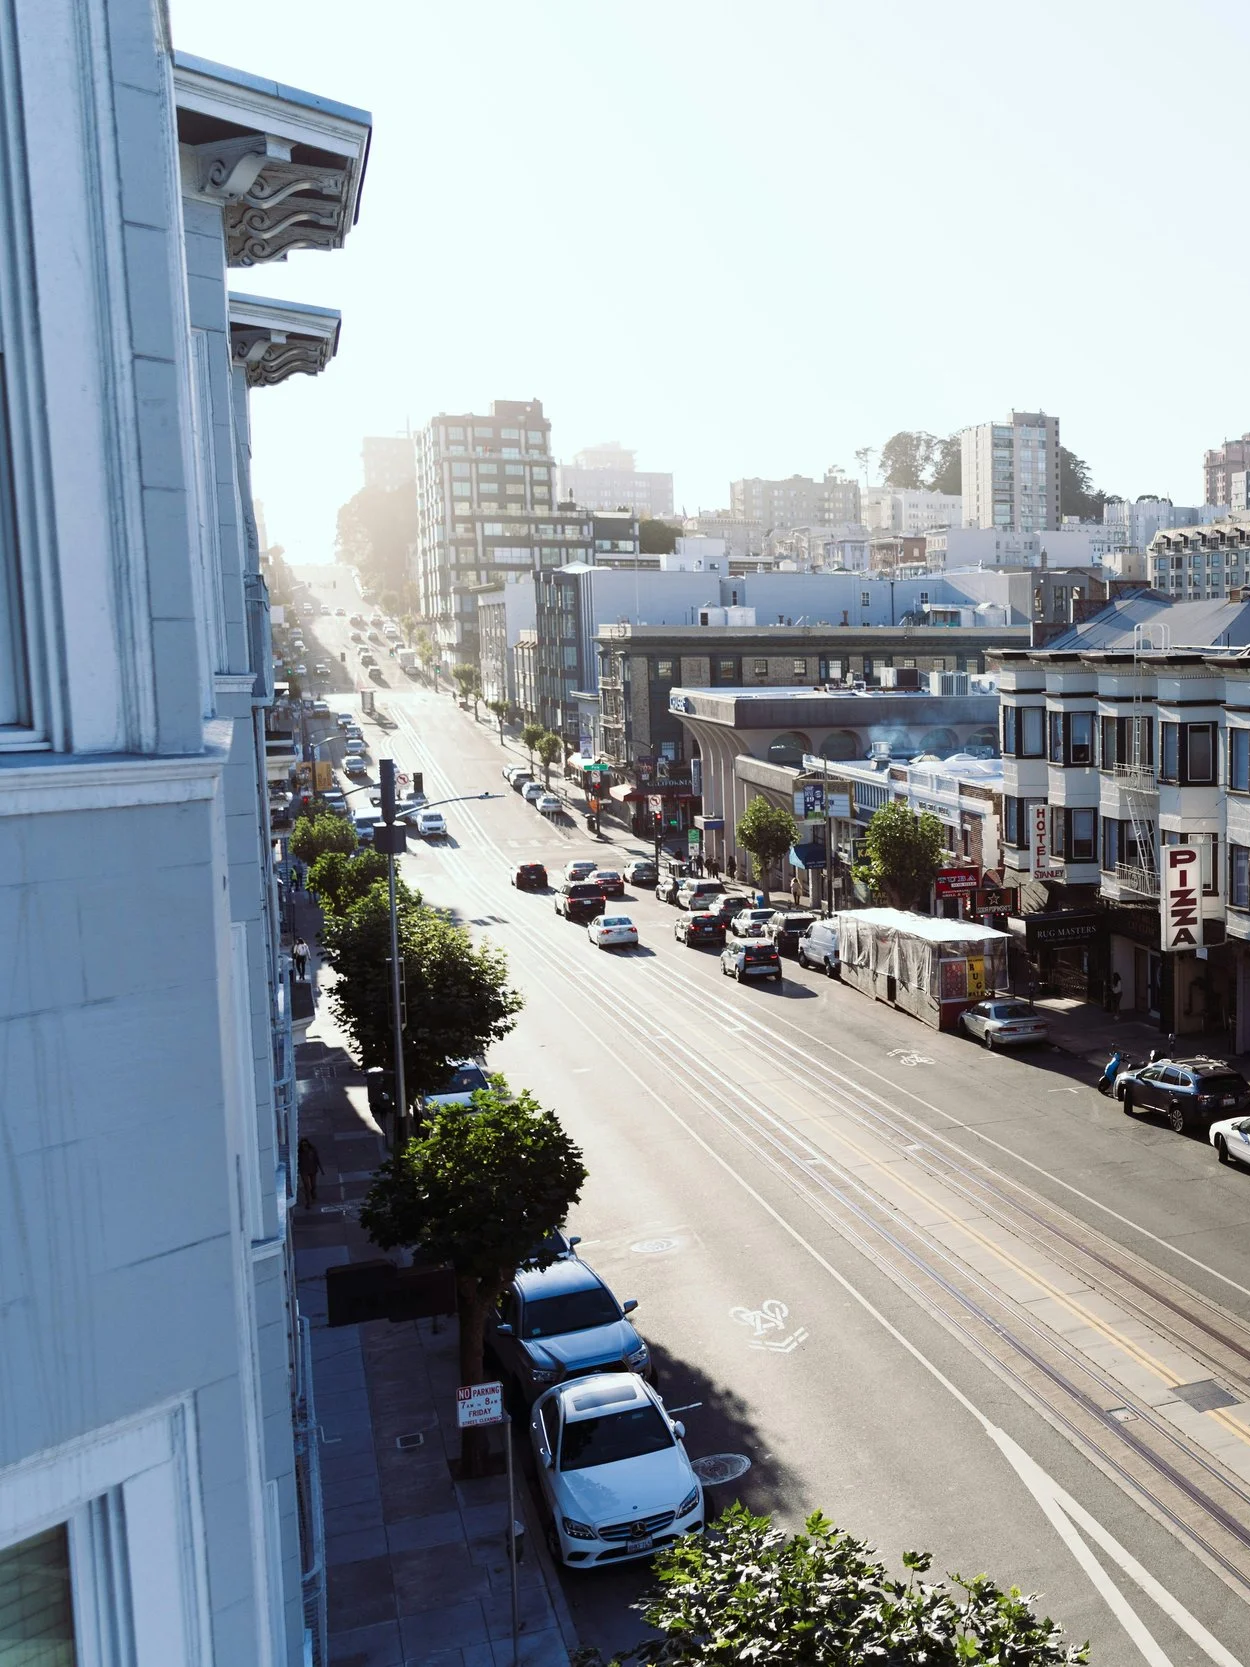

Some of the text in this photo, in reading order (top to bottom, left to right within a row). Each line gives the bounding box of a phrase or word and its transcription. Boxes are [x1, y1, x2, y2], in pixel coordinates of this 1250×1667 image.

[1036, 808, 1046, 868] HOTEL
[937, 874, 977, 884] TUBA
[1034, 869, 1064, 879] STANLEY
[1169, 849, 1198, 947] PIZZA
[1037, 925, 1097, 938] RUG MASTERS
[969, 963, 983, 990] RUG
[459, 1386, 499, 1400] NO PARKING
[469, 1408, 492, 1418] FRIDAY
